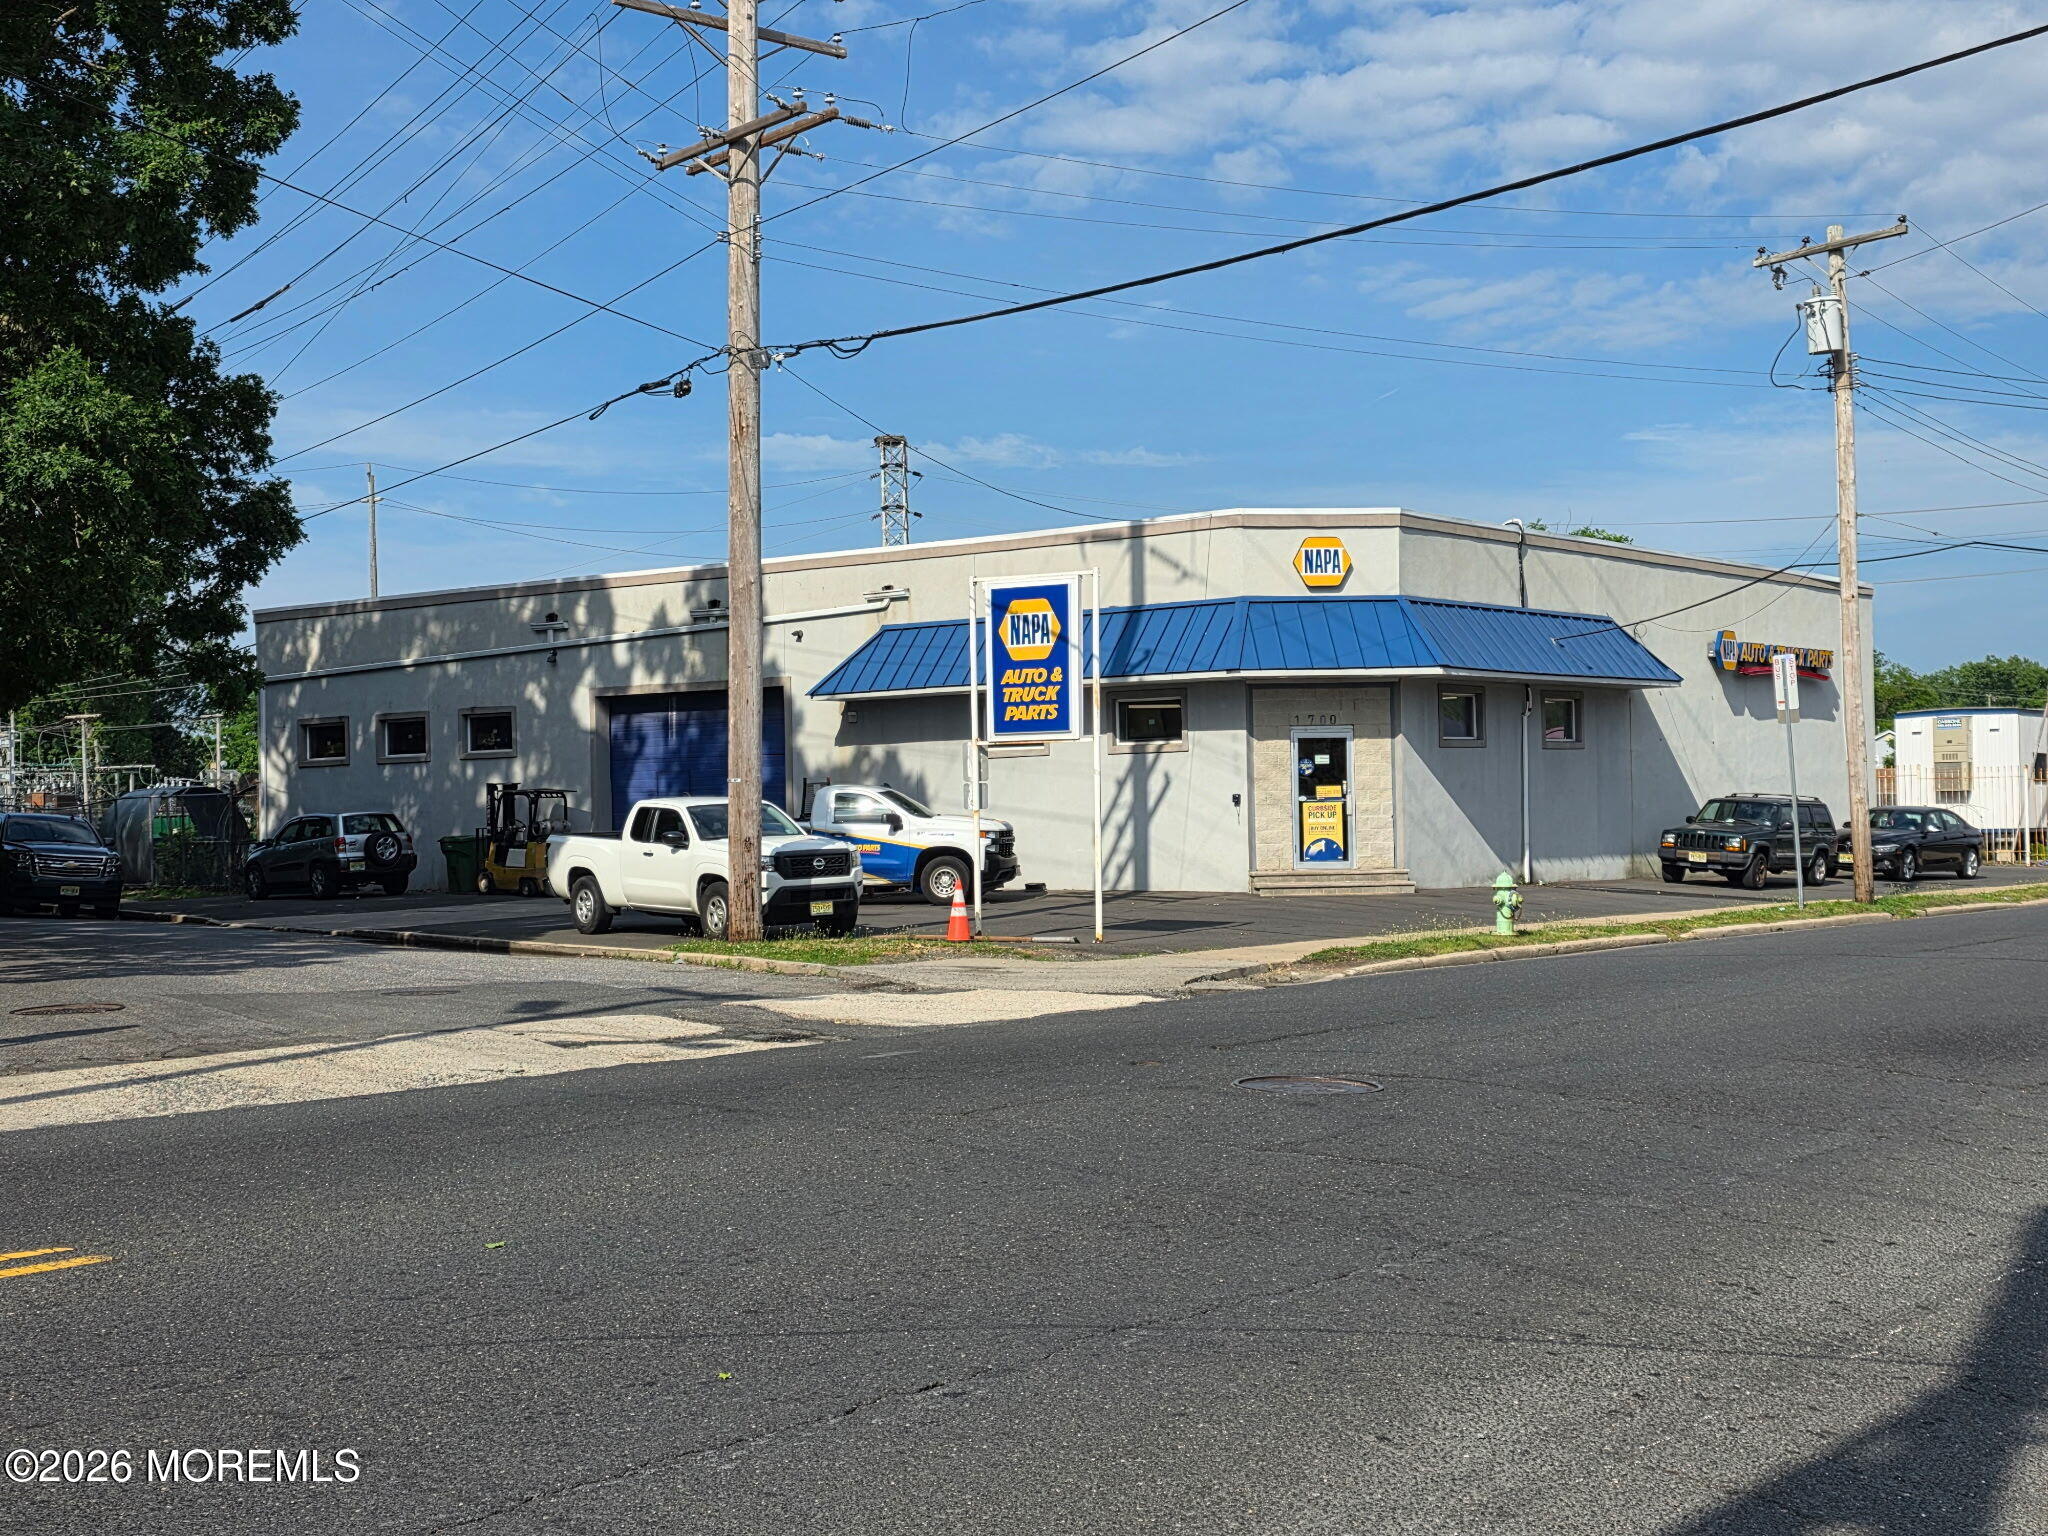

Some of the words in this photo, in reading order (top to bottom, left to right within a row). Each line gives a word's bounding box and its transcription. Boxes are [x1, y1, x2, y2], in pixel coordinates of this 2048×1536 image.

[1304, 549, 1341, 573] NAPA
[1010, 613, 1051, 646] NAPA
[1740, 642, 1765, 663] AUTO
[1807, 648, 1834, 669] PARTS
[1001, 668, 1048, 685] AUTO
[1050, 666, 1063, 682] &
[1774, 658, 1782, 680] BUS
[1788, 657, 1796, 686] STOP
[1002, 685, 1060, 703] TRUCK
[1004, 703, 1059, 721] PARTS
[1294, 714, 1336, 725] 1700
[1308, 811, 1325, 819] PICK
[1327, 811, 1337, 819] UP
